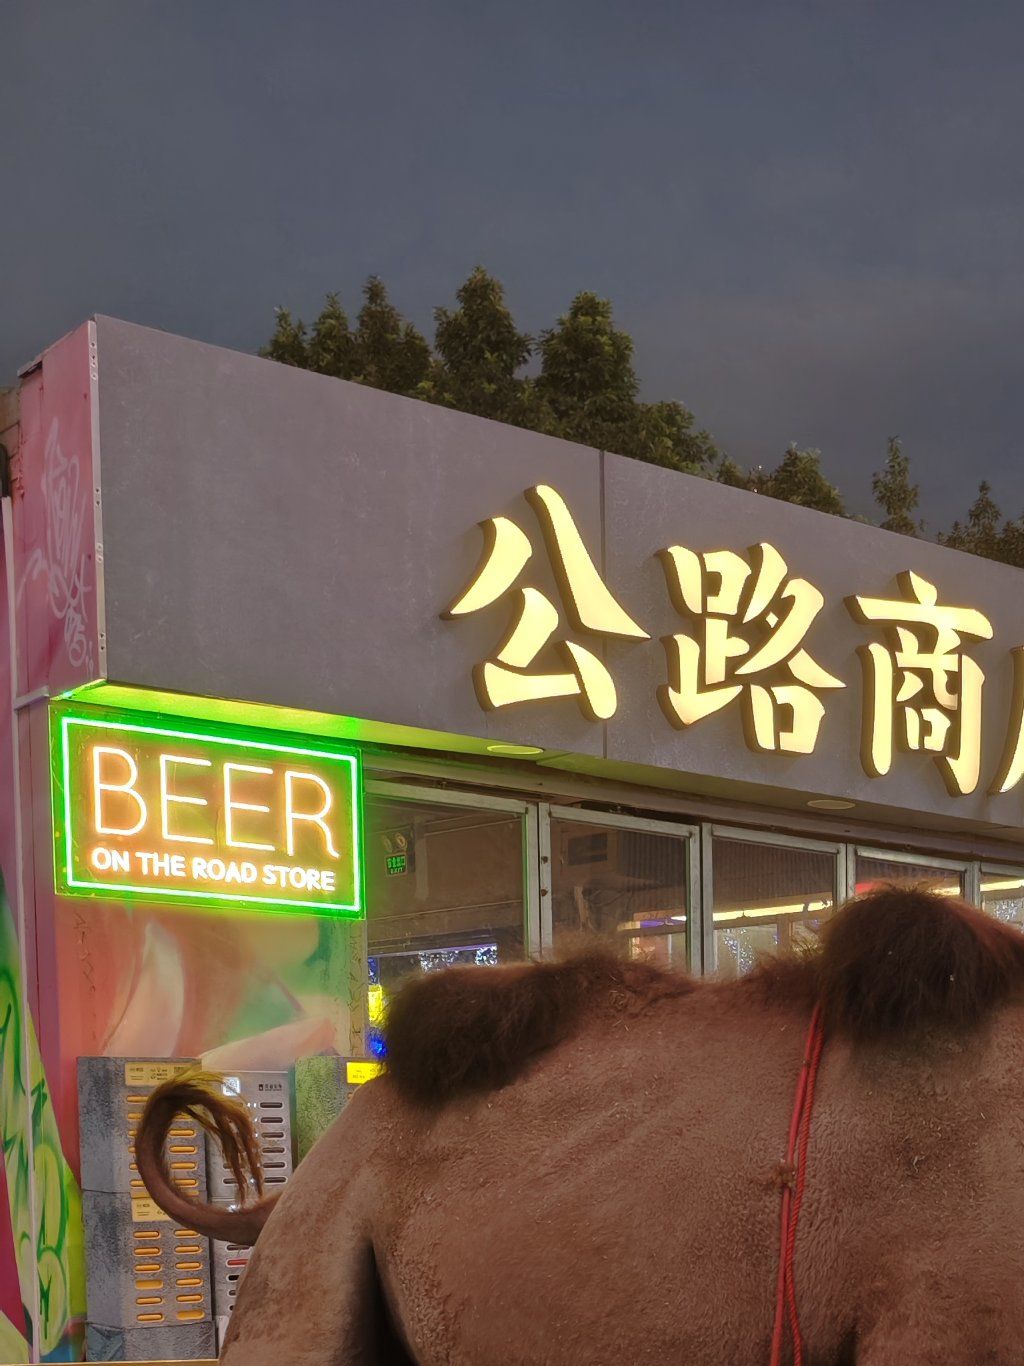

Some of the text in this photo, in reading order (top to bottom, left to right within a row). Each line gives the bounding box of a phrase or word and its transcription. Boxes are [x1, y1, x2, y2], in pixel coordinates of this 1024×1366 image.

[92, 746, 341, 860] BEER
[90, 847, 337, 892] ON THE ROAD STORE
